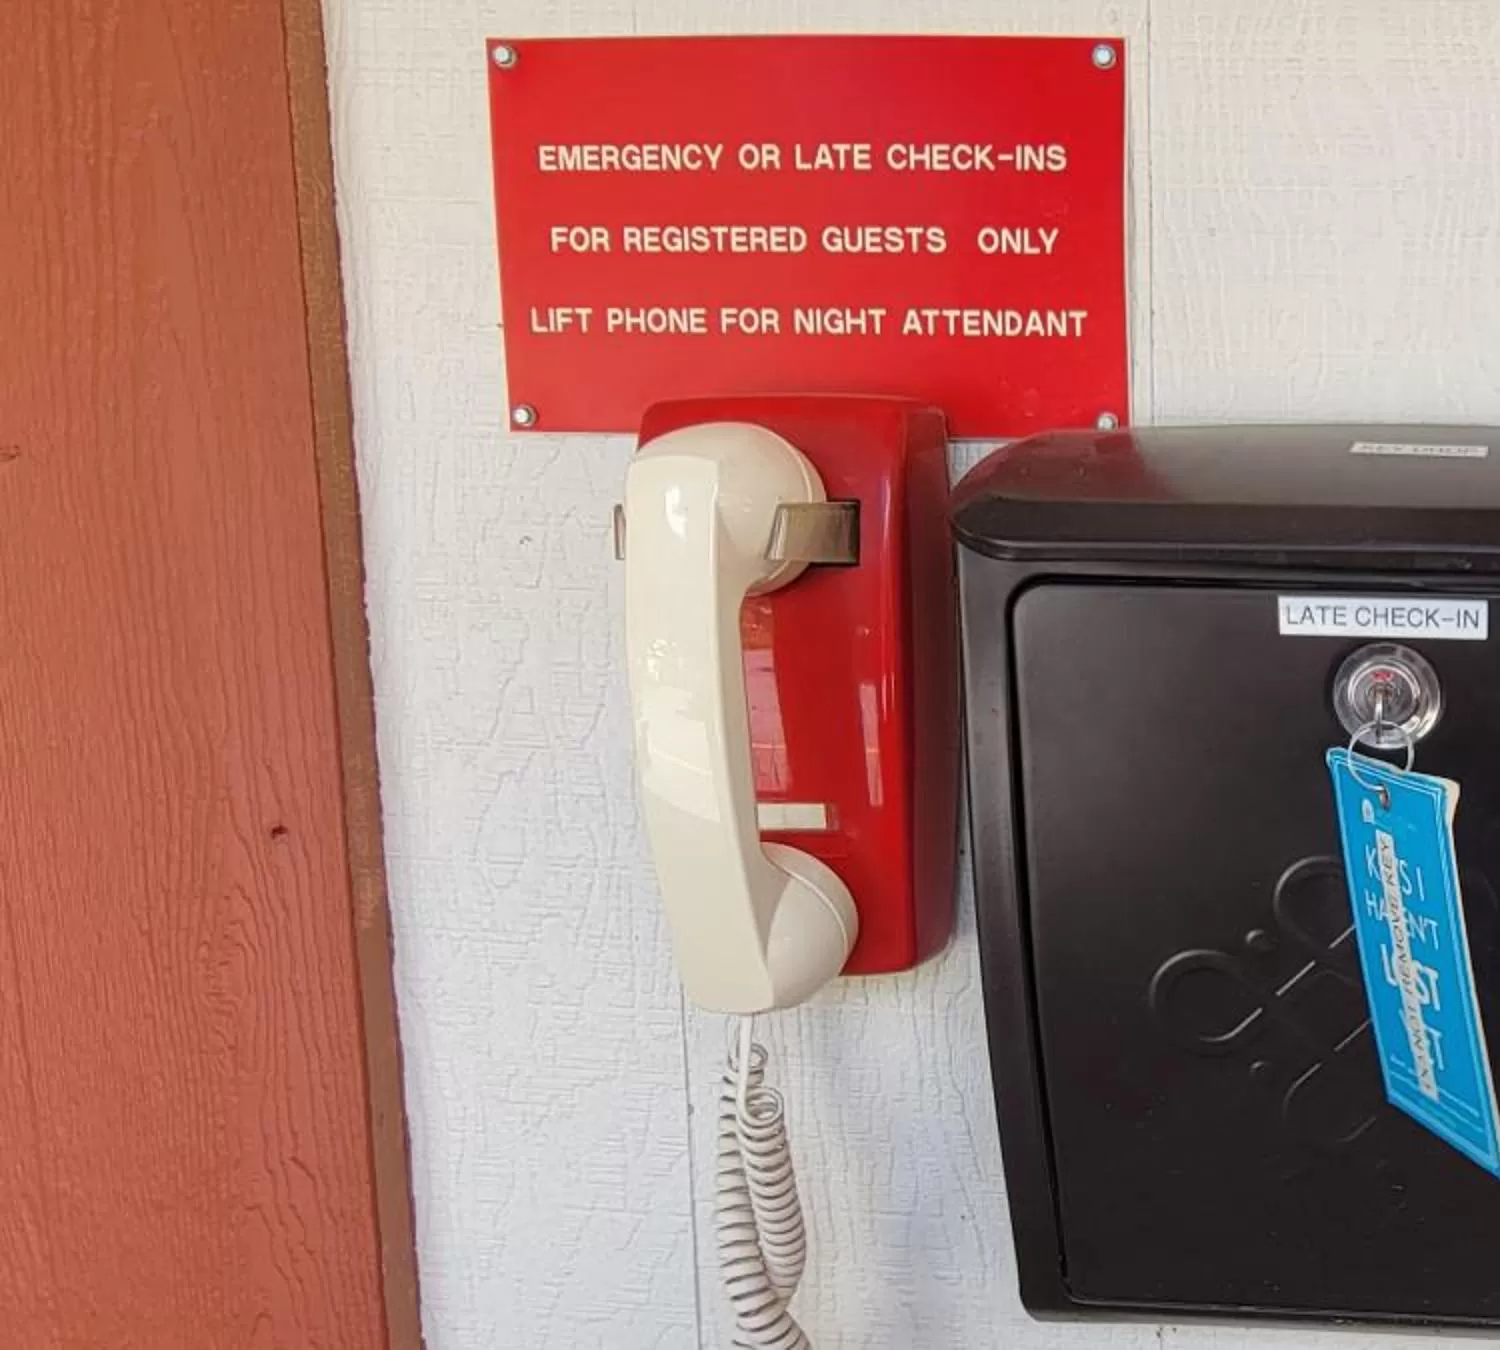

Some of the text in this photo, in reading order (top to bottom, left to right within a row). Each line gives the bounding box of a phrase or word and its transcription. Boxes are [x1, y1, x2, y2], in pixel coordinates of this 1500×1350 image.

[538, 143, 1067, 172] EMERGENCY OR LATE CHECK-INS
[551, 225, 1059, 254] FOR REGISTERED GUESTS ONLY
[530, 307, 1088, 337] LIFT PHONE FOR NIGHT ATTENDANT
[1285, 605, 1480, 629] LATE CHECK-IN
[1379, 836, 1395, 887] KEY
